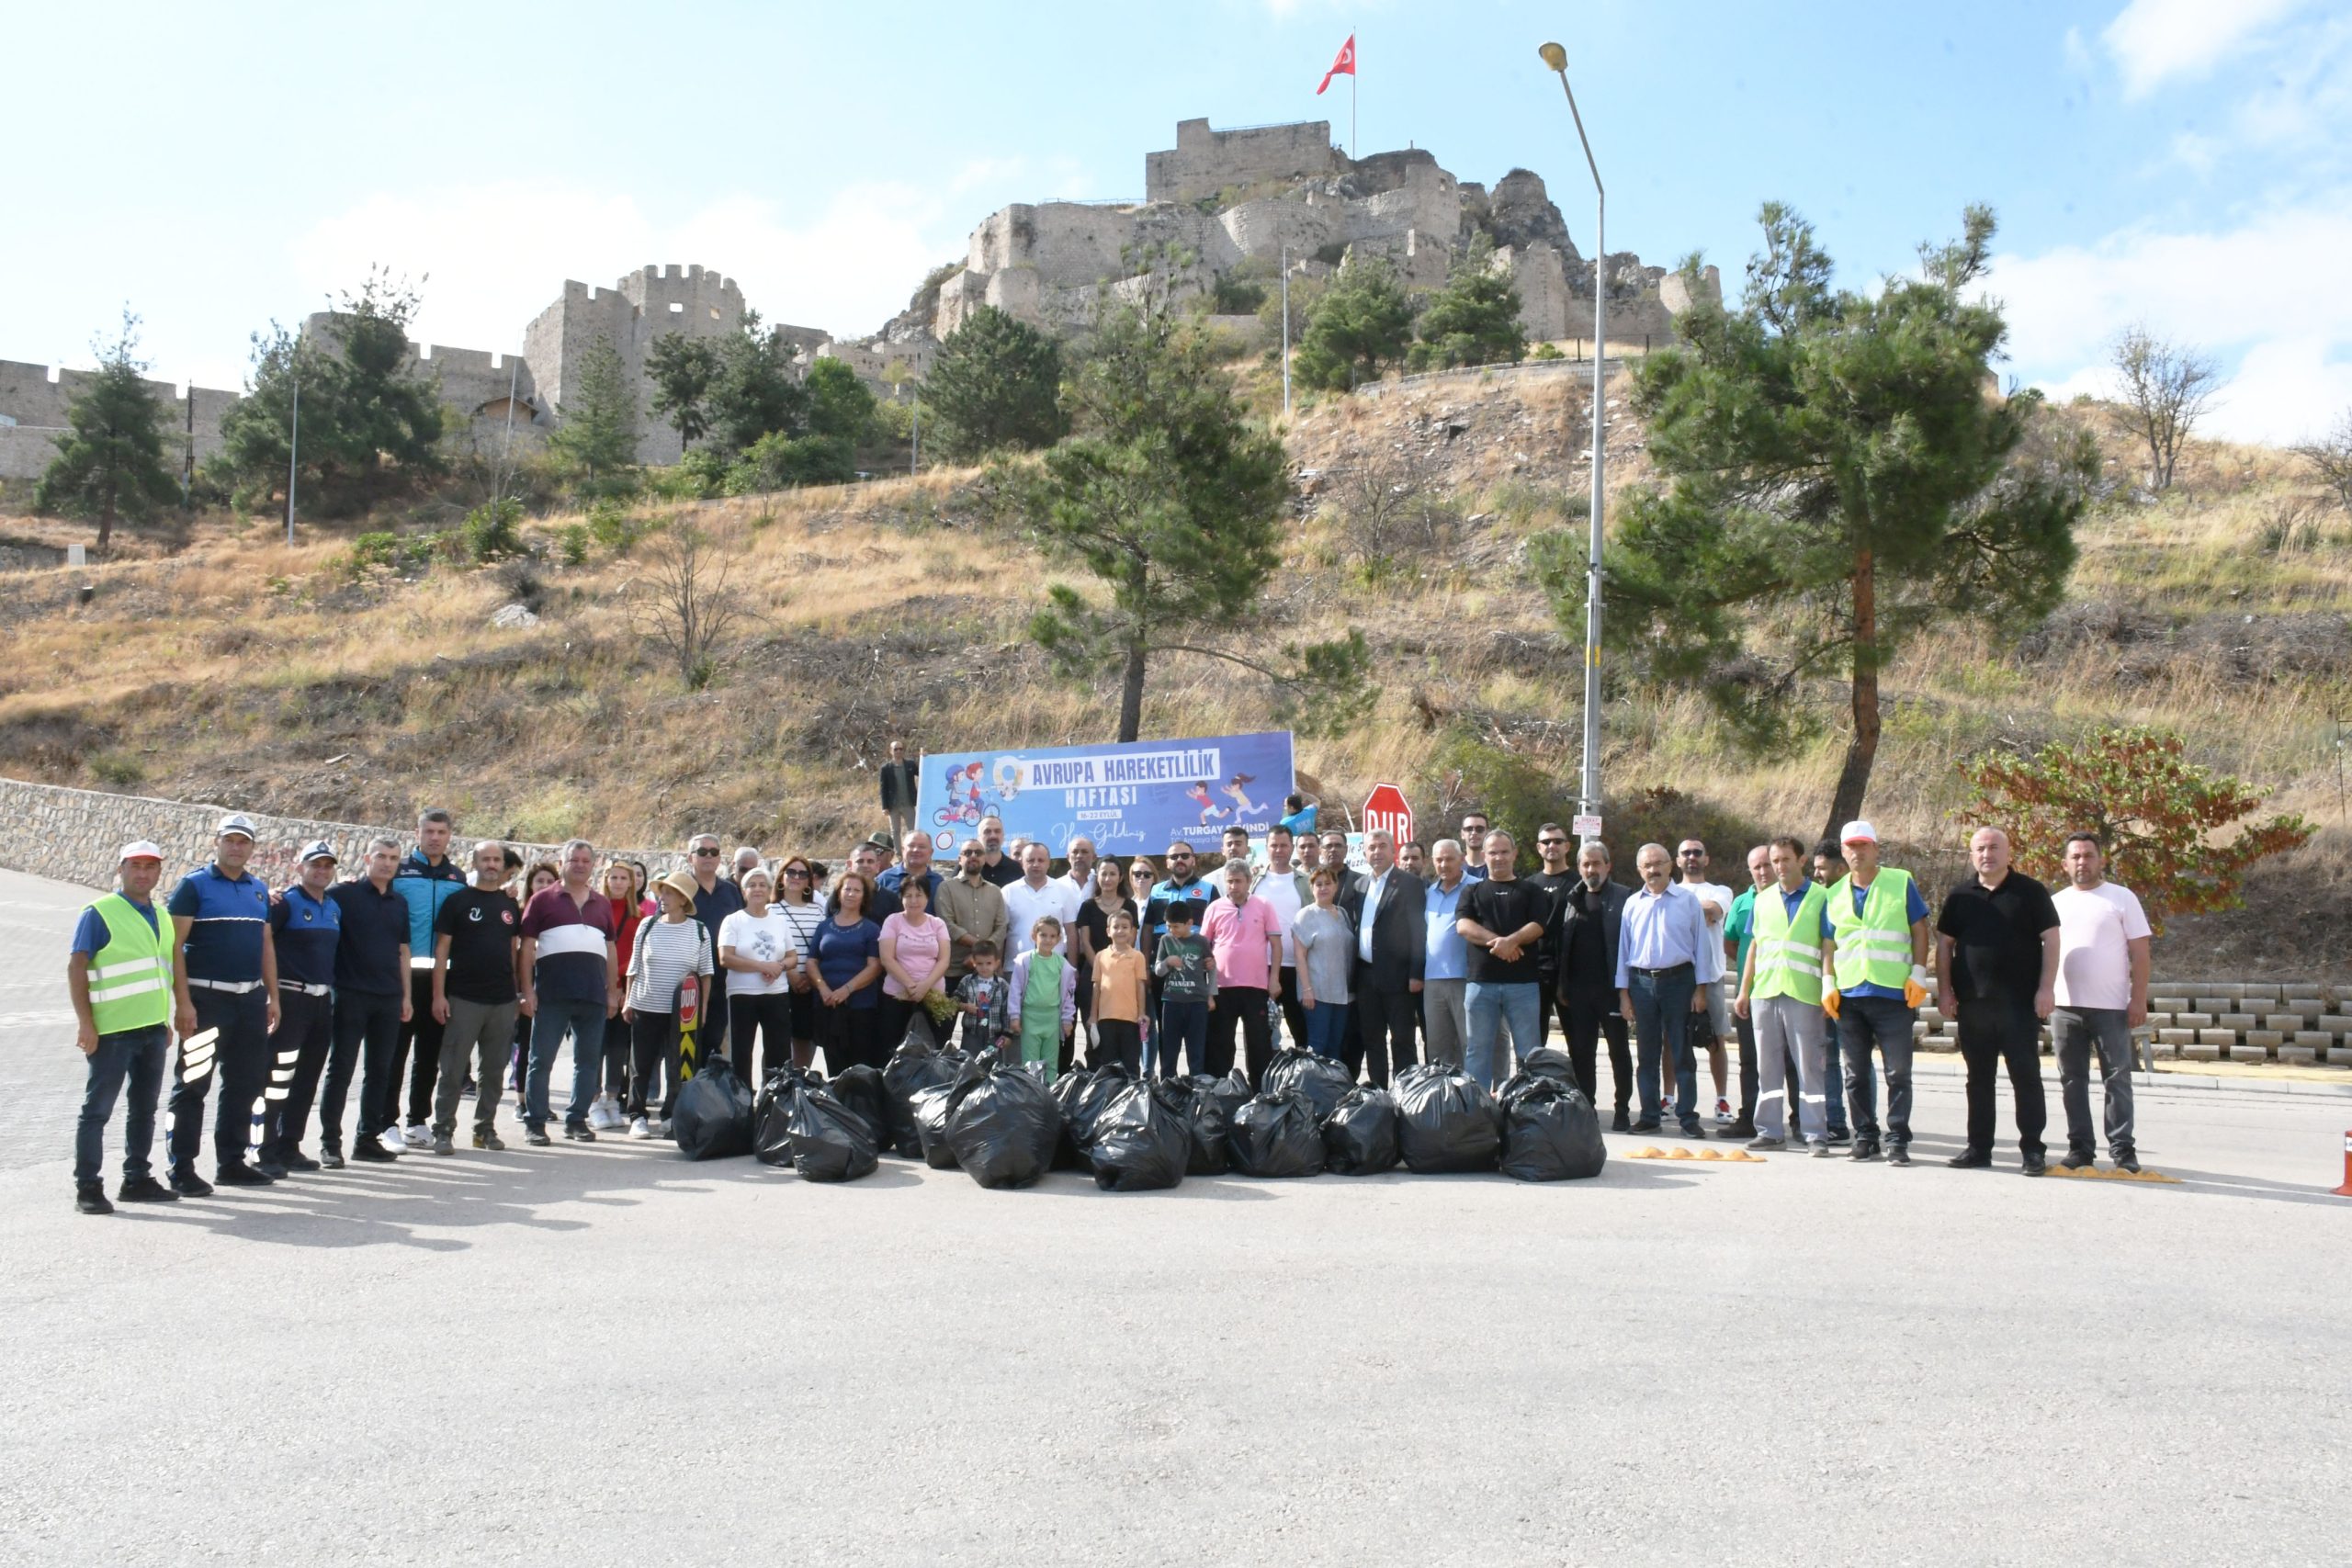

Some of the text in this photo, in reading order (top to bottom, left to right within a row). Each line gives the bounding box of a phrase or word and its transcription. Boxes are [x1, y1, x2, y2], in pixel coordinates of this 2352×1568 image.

[1033, 752, 1214, 785] AVRUPA HAREKETLİLİK
[1065, 786, 1137, 808] HAFTASI
[1367, 809, 1408, 845] DUR
